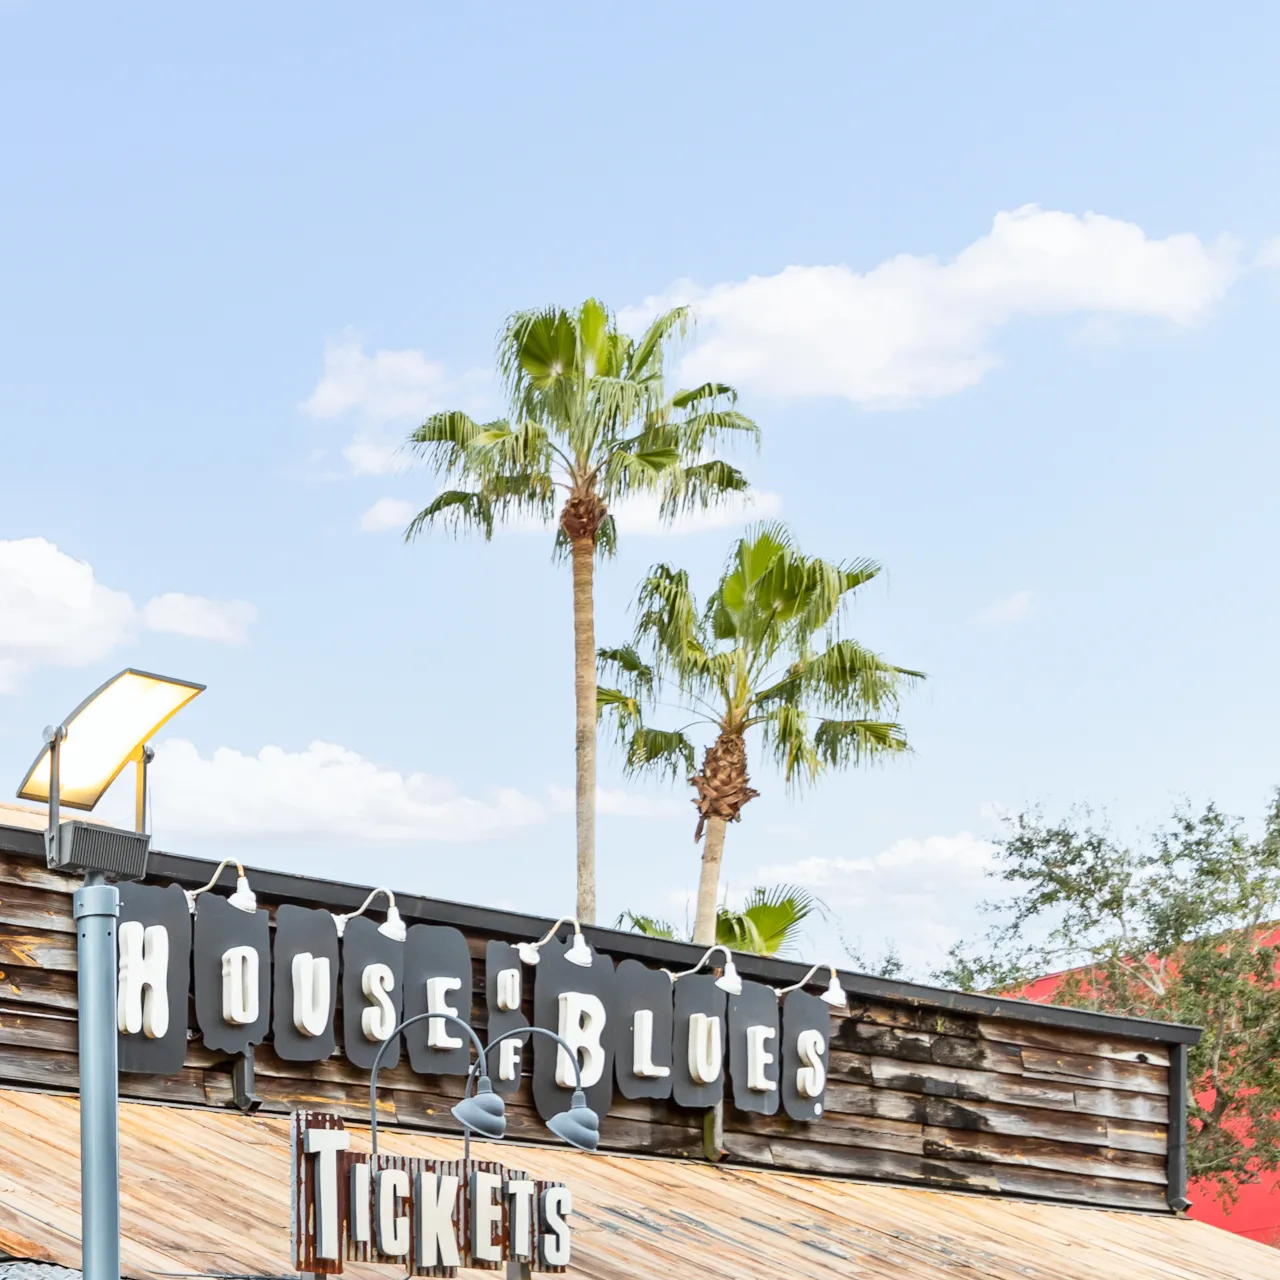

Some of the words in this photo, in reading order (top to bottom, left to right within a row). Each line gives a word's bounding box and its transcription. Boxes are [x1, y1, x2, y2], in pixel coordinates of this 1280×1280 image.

[118, 920, 463, 1050] HOUSE
[497, 968, 524, 1081] OF
[556, 992, 826, 1099] BLUES
[303, 1127, 573, 1268] TICKETS
